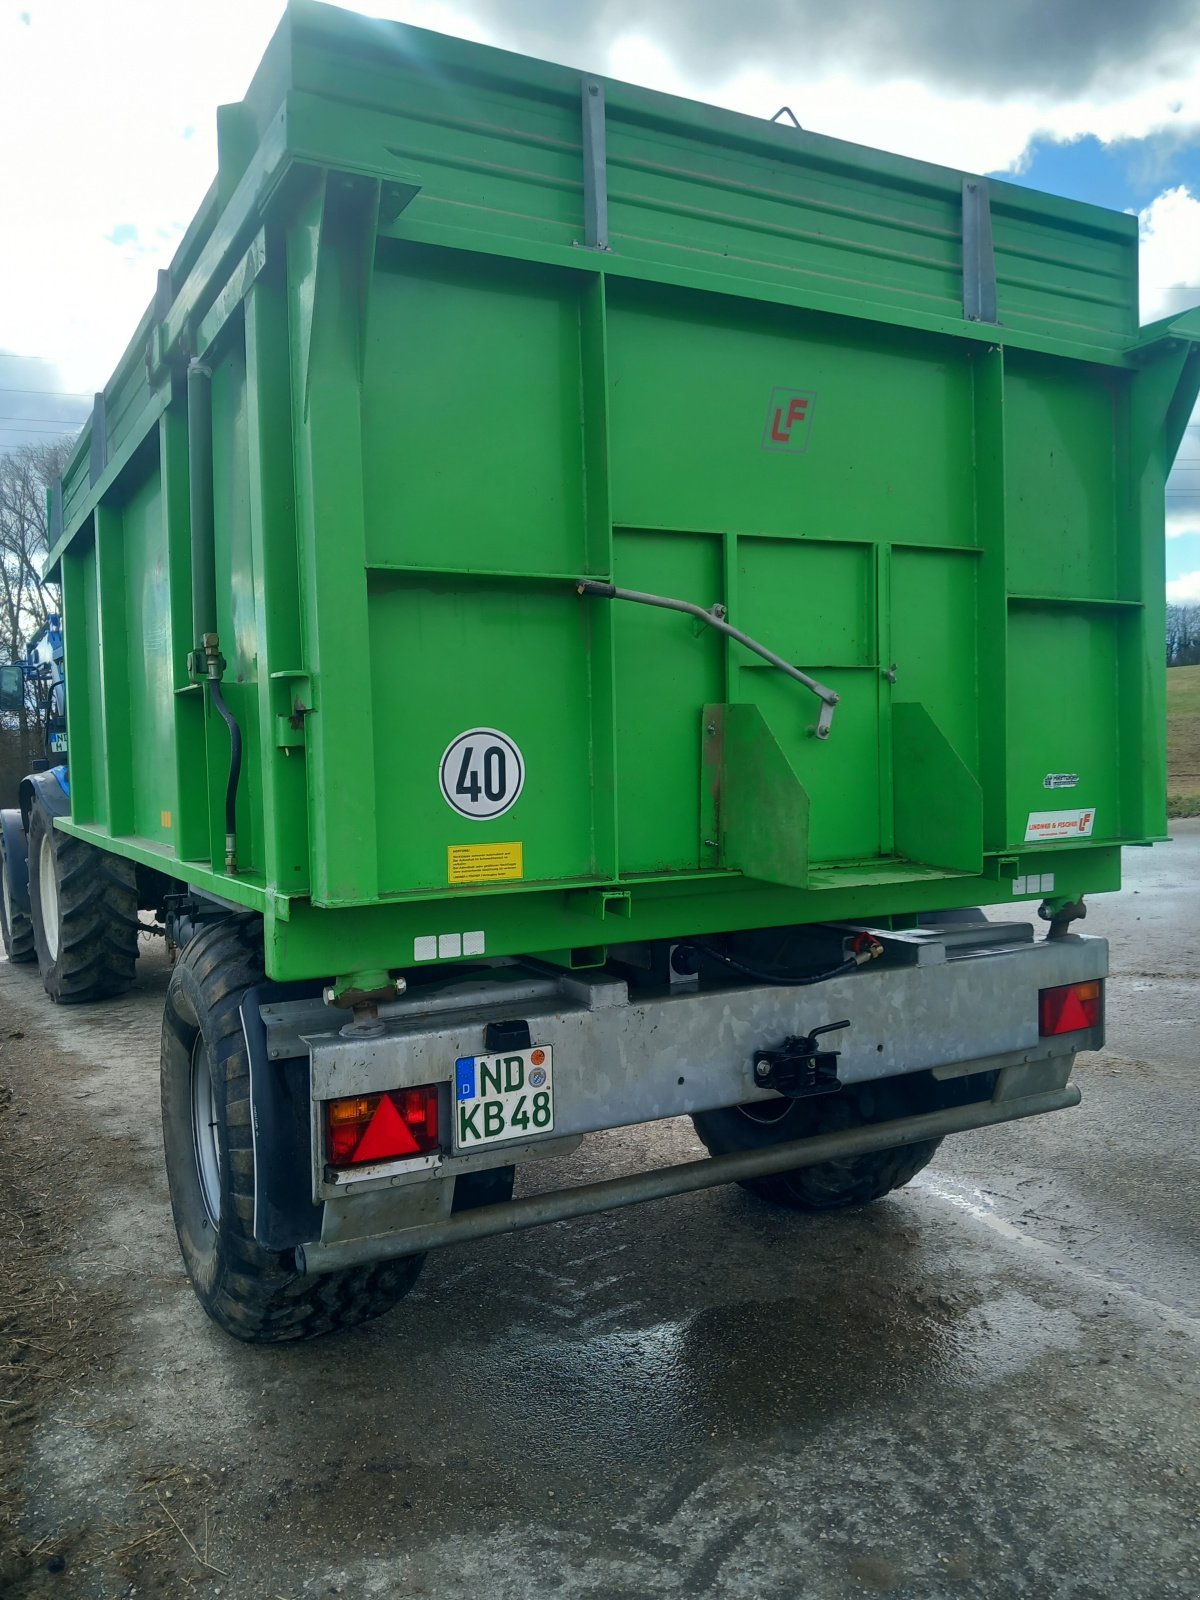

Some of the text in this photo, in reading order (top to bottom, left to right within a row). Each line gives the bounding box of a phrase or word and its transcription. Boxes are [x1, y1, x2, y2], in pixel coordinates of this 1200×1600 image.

[455, 746, 506, 803] 40
[462, 1083, 470, 1095] D
[480, 1055, 525, 1098] ND
[460, 1091, 551, 1142] KB 48
